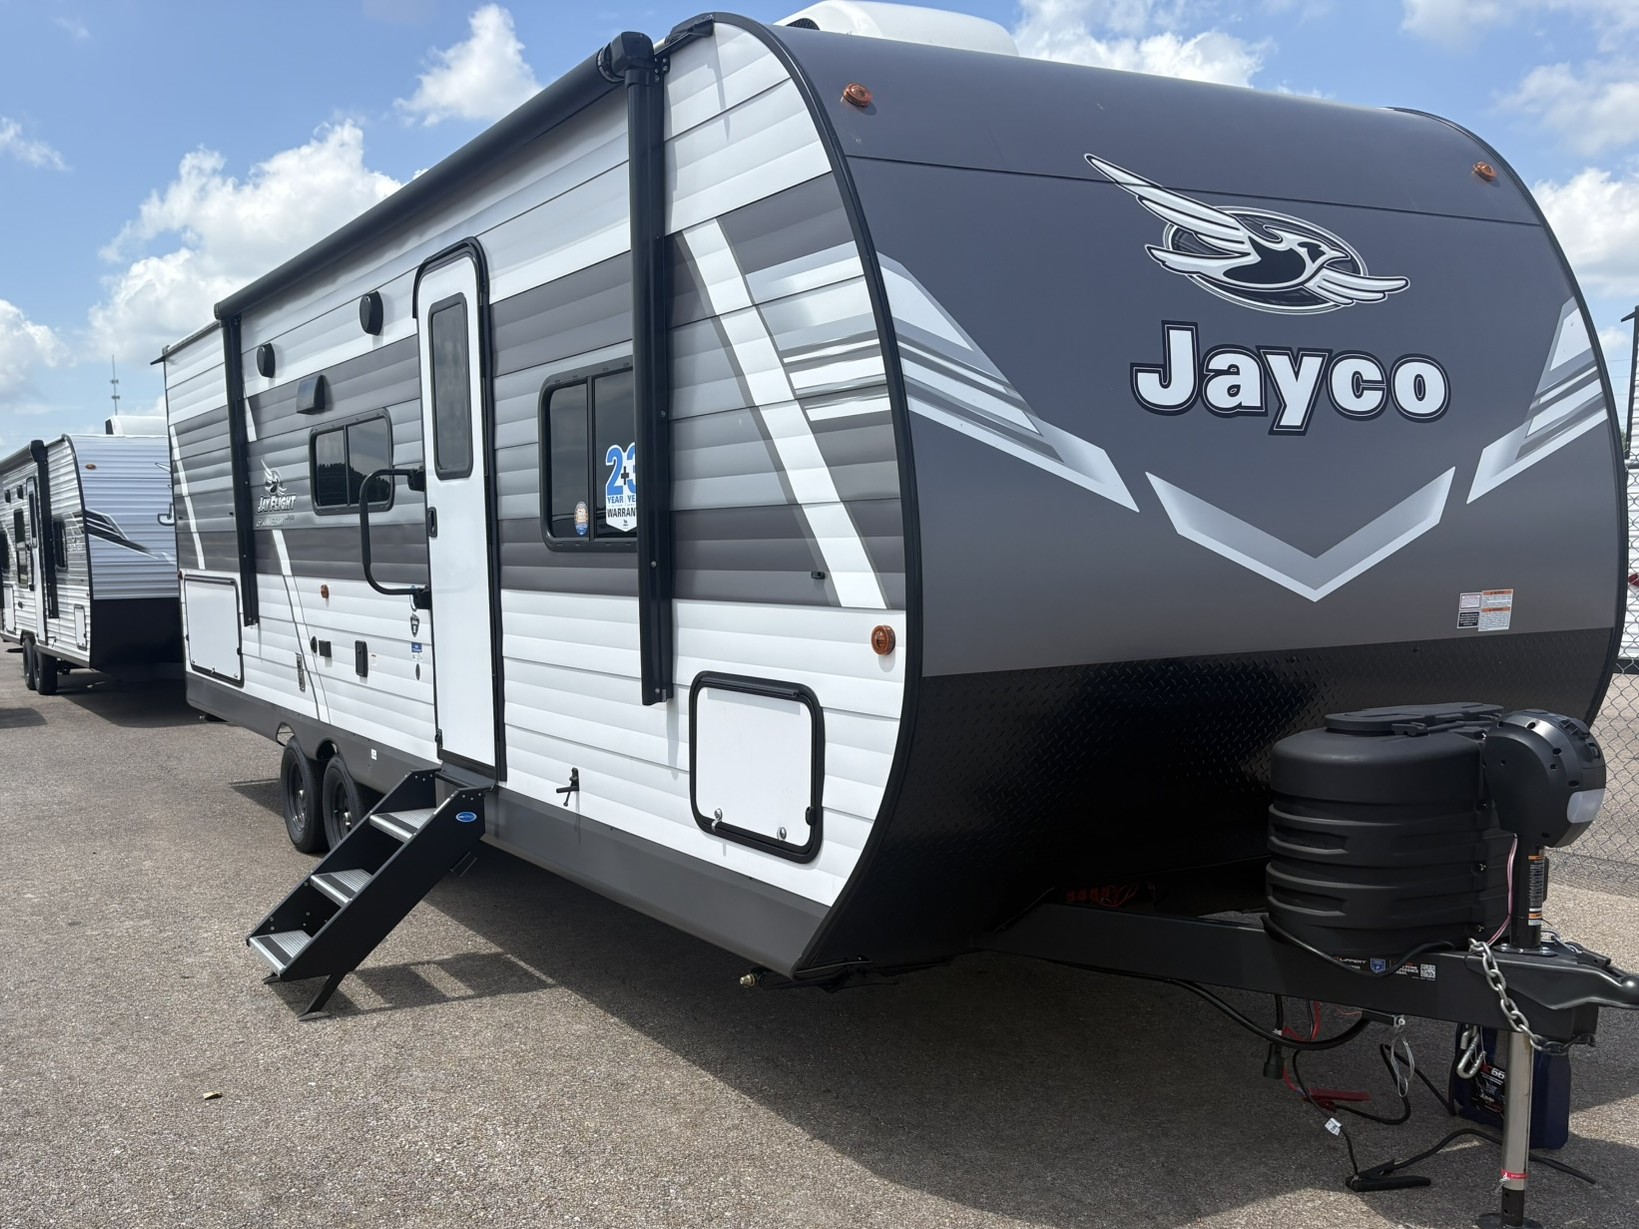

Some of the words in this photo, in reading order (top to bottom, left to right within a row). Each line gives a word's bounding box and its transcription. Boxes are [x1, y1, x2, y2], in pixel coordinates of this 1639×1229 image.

[1130, 320, 1452, 436] Jayco
[257, 496, 270, 513] JAY
[269, 495, 296, 511] FLIGHT
[607, 496, 624, 505] YEAR
[607, 507, 636, 518] WARRAN
